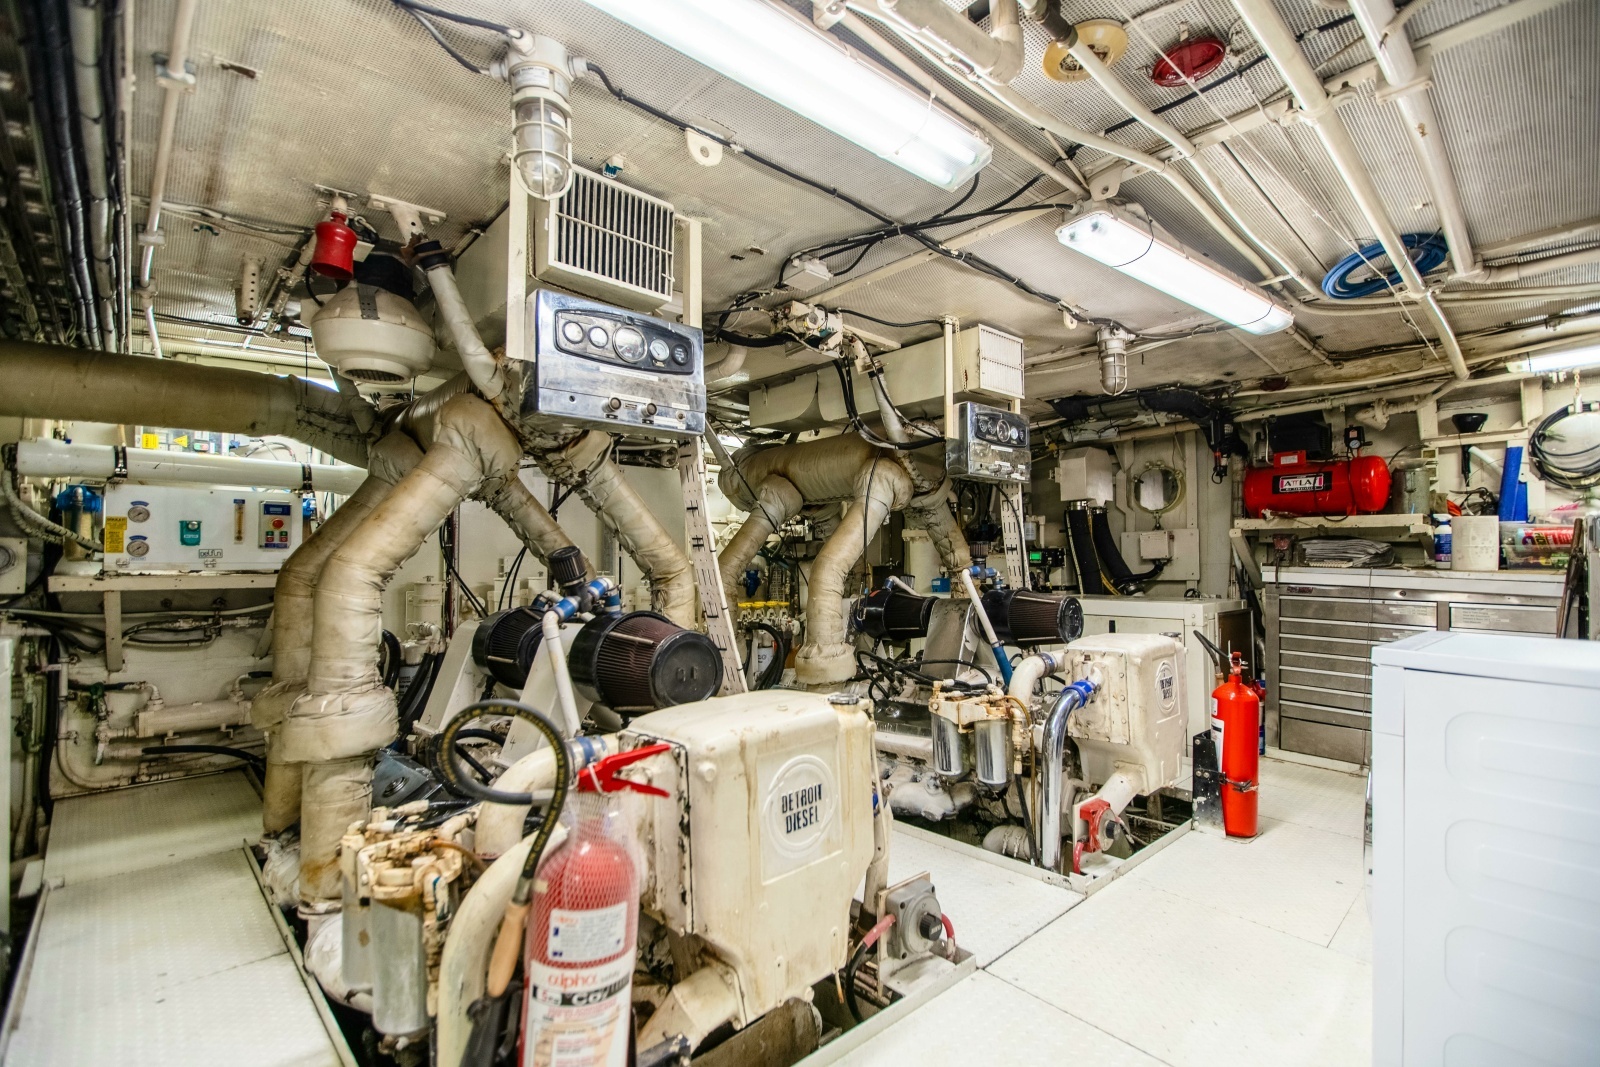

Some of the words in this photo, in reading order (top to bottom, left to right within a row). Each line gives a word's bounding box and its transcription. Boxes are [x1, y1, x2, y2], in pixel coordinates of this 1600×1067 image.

[1285, 477, 1318, 487] ATTLA
[781, 784, 822, 814] DETROIT
[786, 805, 819, 834] DIESEL
[548, 973, 597, 988] alpha
